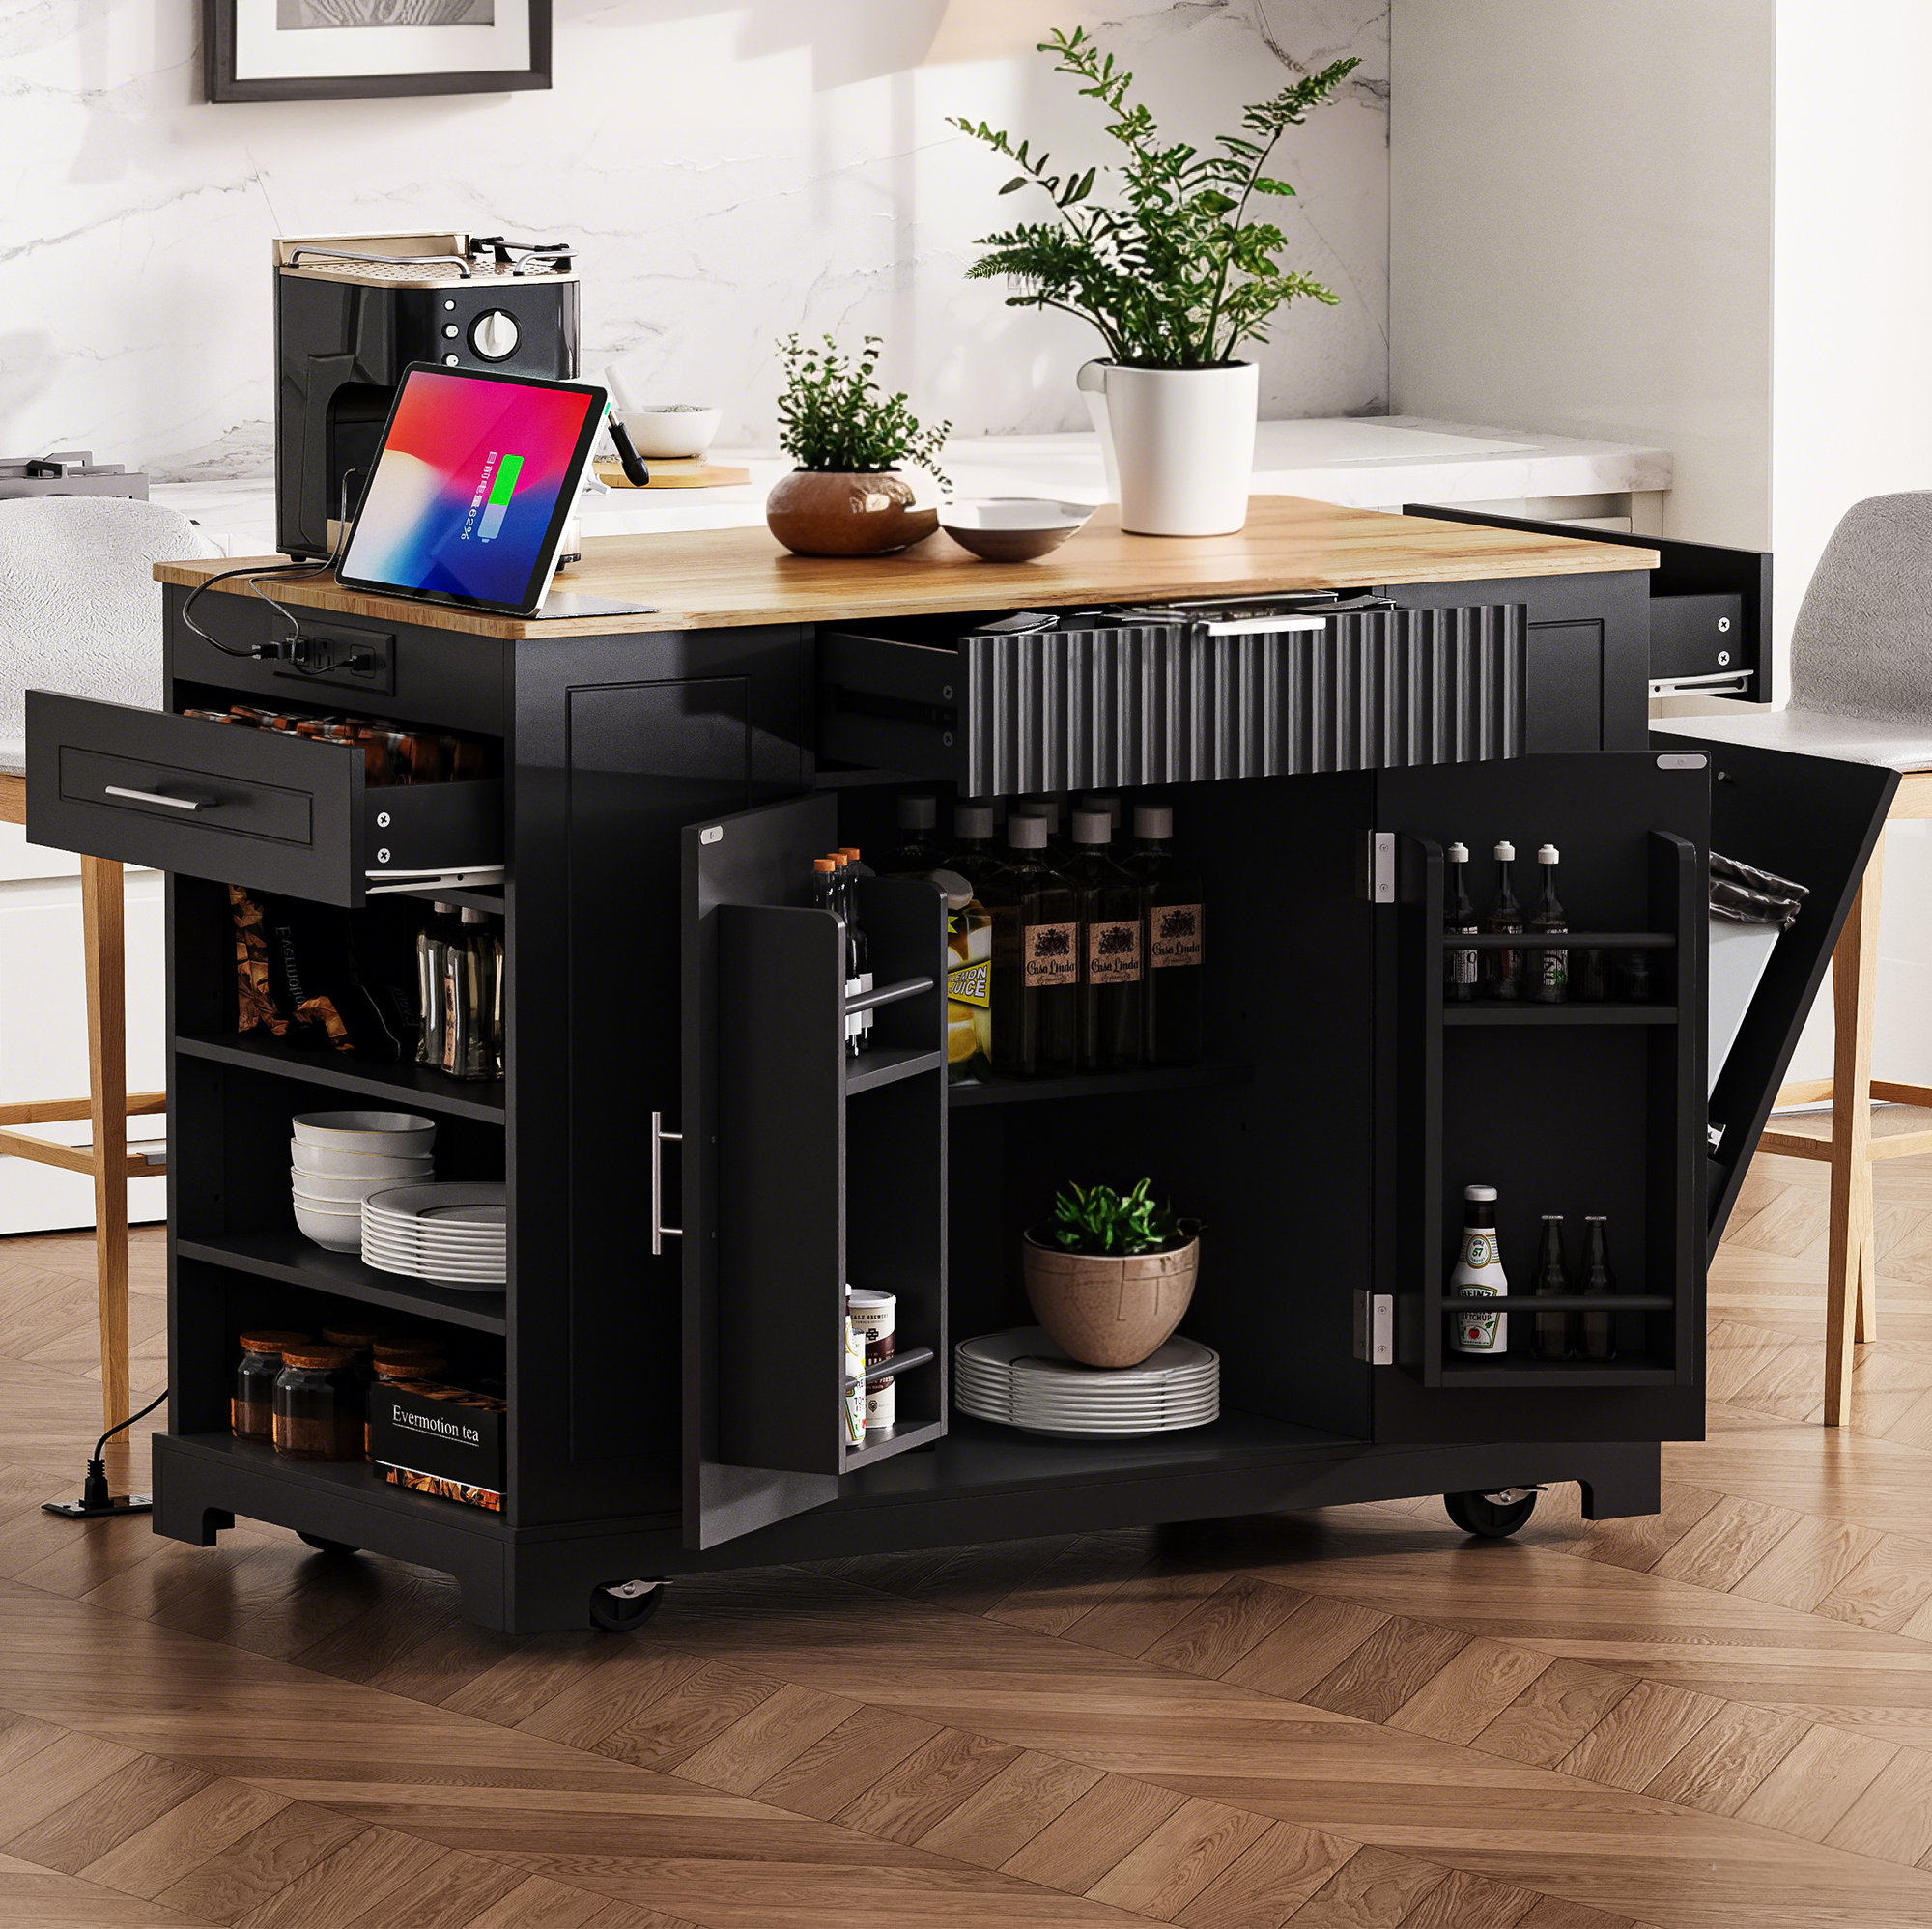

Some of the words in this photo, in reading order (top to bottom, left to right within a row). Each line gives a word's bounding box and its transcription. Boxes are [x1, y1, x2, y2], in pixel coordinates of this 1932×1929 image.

[460, 451, 497, 540] 目前电量62%
[951, 964, 987, 982] LEMON
[1027, 960, 1048, 976] Casa
[1049, 959, 1075, 975] Linda
[1092, 958, 1112, 973] Casa
[1113, 957, 1138, 972] Linda
[949, 979, 986, 997] JUICE
[1472, 1248, 1484, 1257] 57
[1462, 1313, 1492, 1321] KETCHUP
[392, 1404, 459, 1437] Evermotion
[462, 1425, 480, 1442] tea
